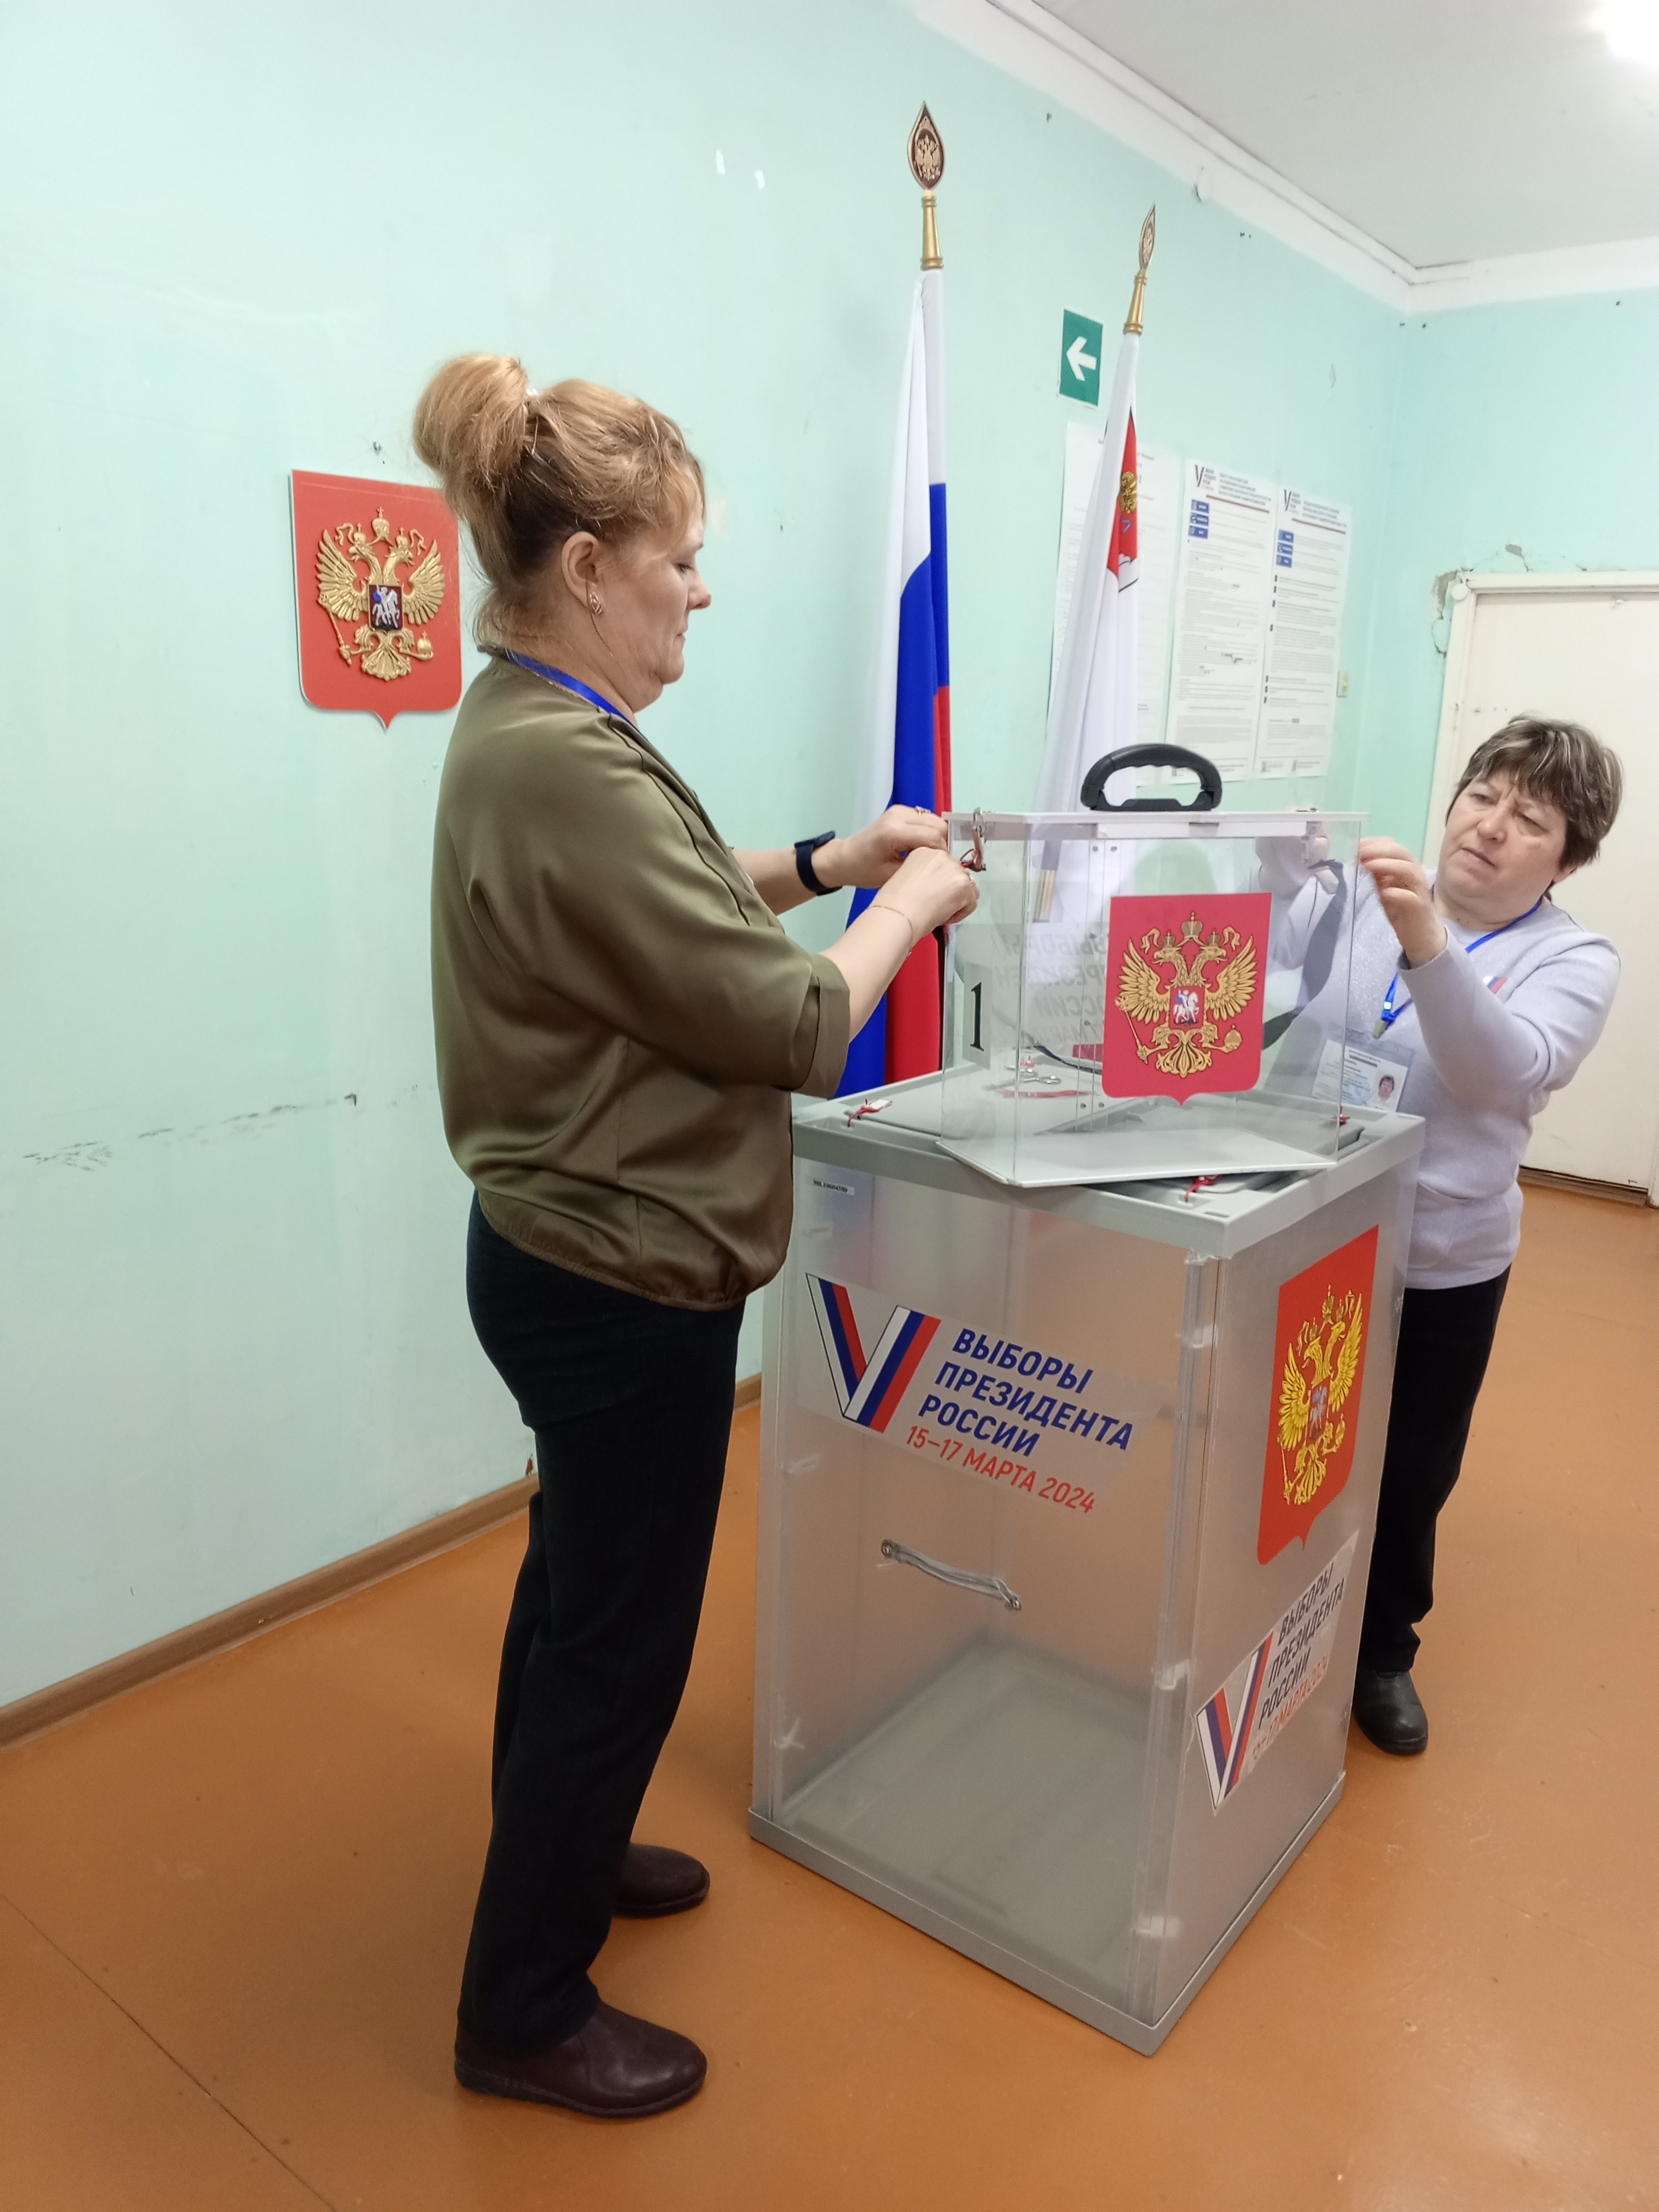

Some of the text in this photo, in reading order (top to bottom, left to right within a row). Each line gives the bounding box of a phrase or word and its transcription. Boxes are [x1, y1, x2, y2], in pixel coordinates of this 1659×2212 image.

[970, 981, 984, 1052] 1
[952, 1328, 1093, 1393] ВЫБОРЫ
[918, 1393, 1041, 1458] РОССИИ
[935, 1361, 1134, 1451] ПРЕЗИДЕНТА
[962, 1447, 1037, 1492] МАРТА
[1037, 1477, 1096, 1514] 2024
[1268, 1577, 1344, 1688] ПРЕЗИДЕНТА
[1277, 1562, 1334, 1646] ВЫБОРЫ
[1258, 1646, 1311, 1730] РОССИИ
